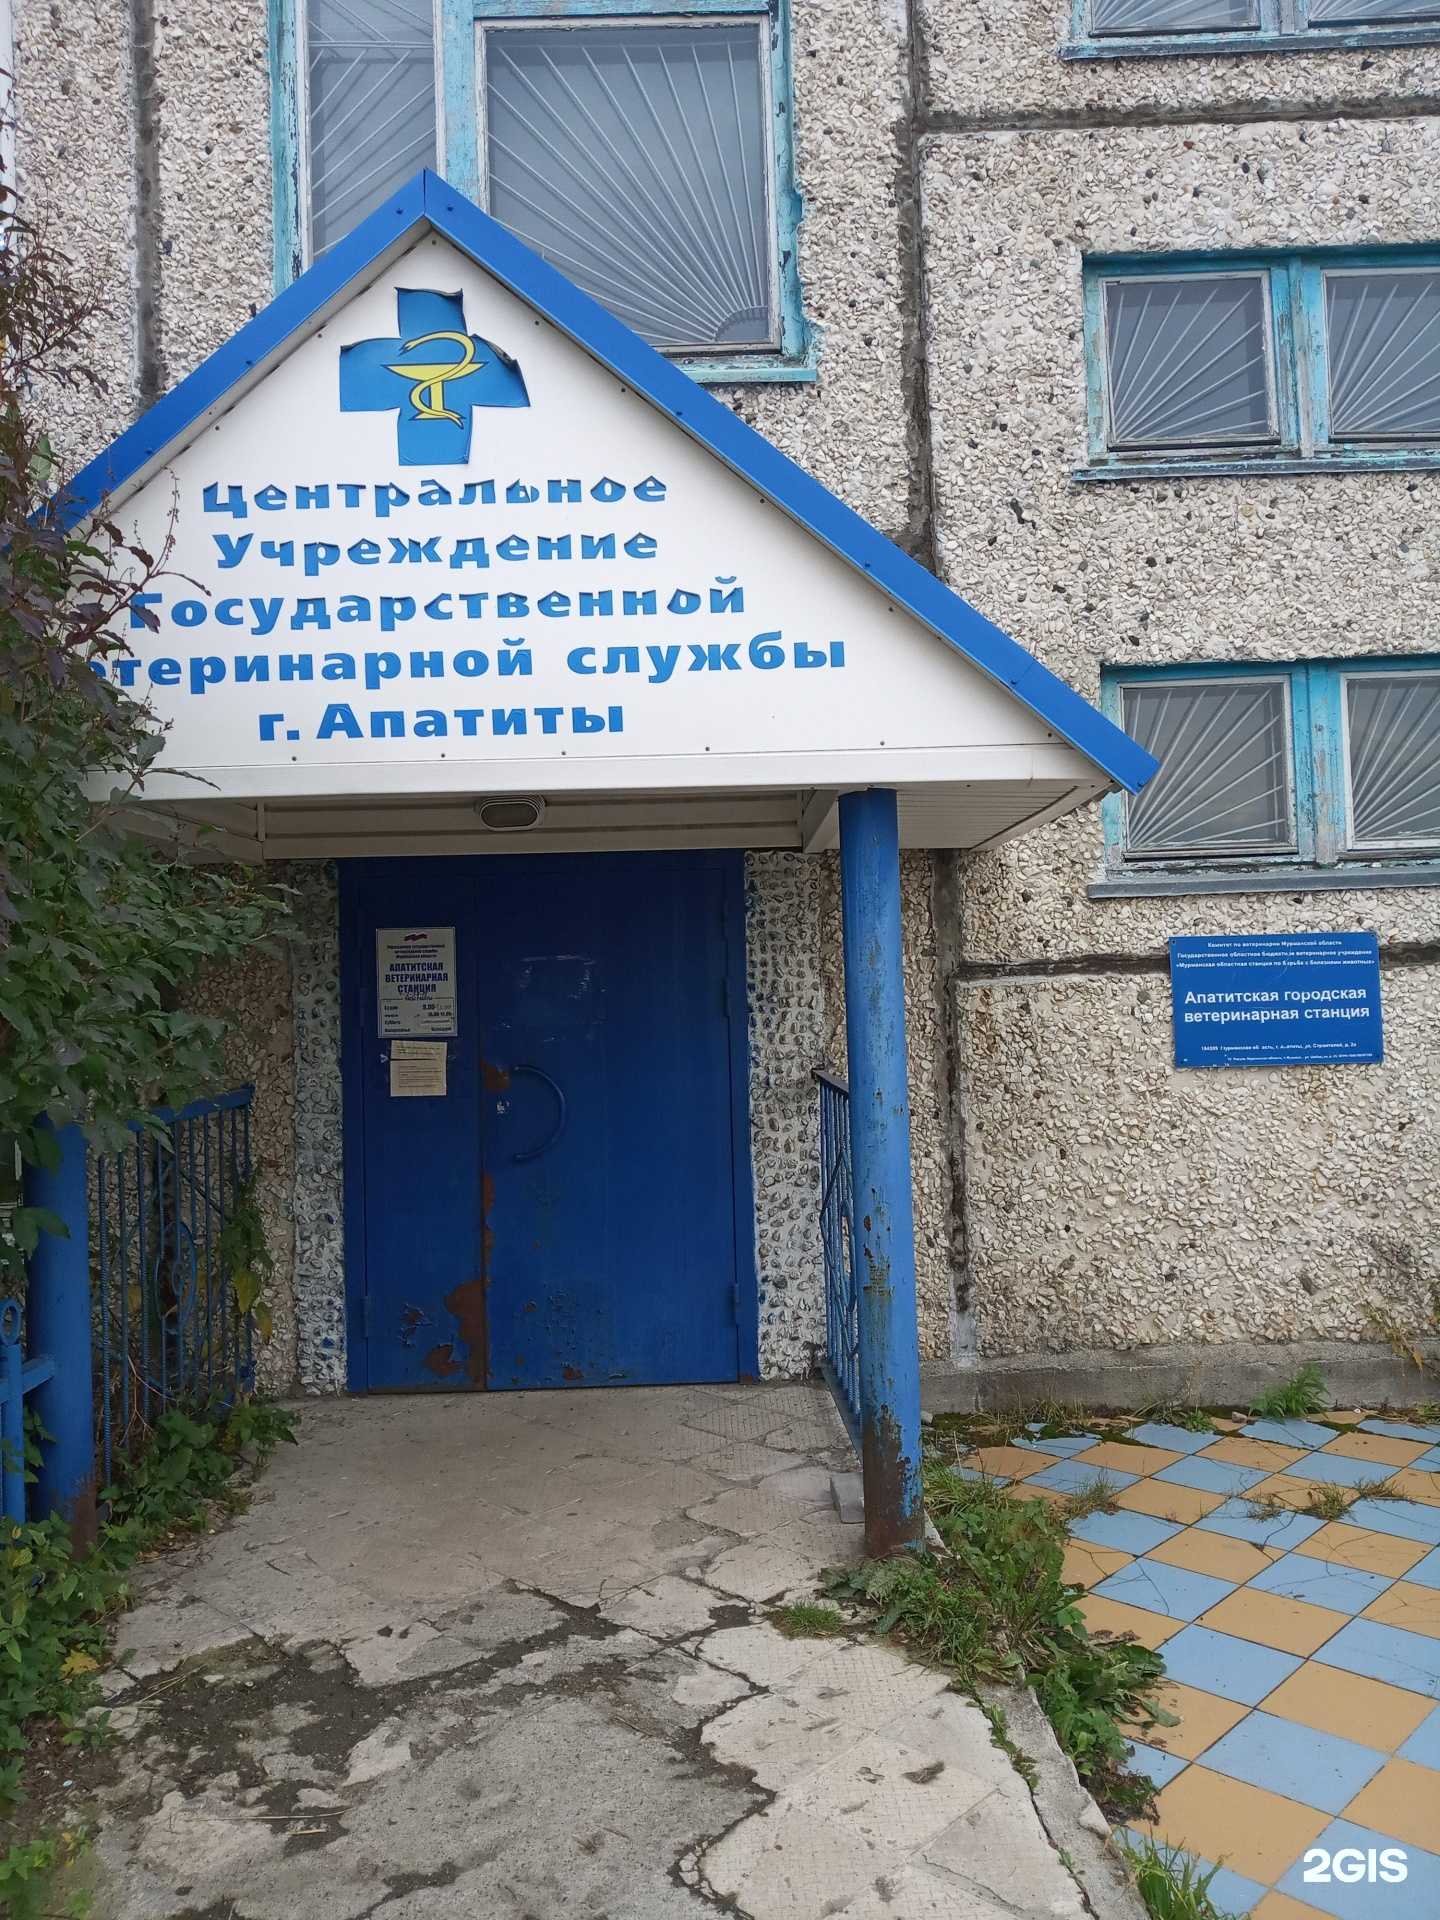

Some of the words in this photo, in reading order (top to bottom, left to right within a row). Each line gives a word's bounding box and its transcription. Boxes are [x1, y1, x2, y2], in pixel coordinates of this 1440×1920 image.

[202, 475, 668, 519] Центральное
[211, 532, 658, 576] Учреждение
[128, 576, 745, 635] Государственной
[88, 637, 533, 694] теринарной
[566, 630, 845, 684] службы
[258, 713, 300, 741] г.
[316, 703, 624, 739] Апатиты
[1184, 990, 1279, 1004] Апатитская
[1284, 988, 1367, 1003] городская
[1184, 1007, 1299, 1024] ветеринарная
[1304, 1006, 1370, 1020] станция
